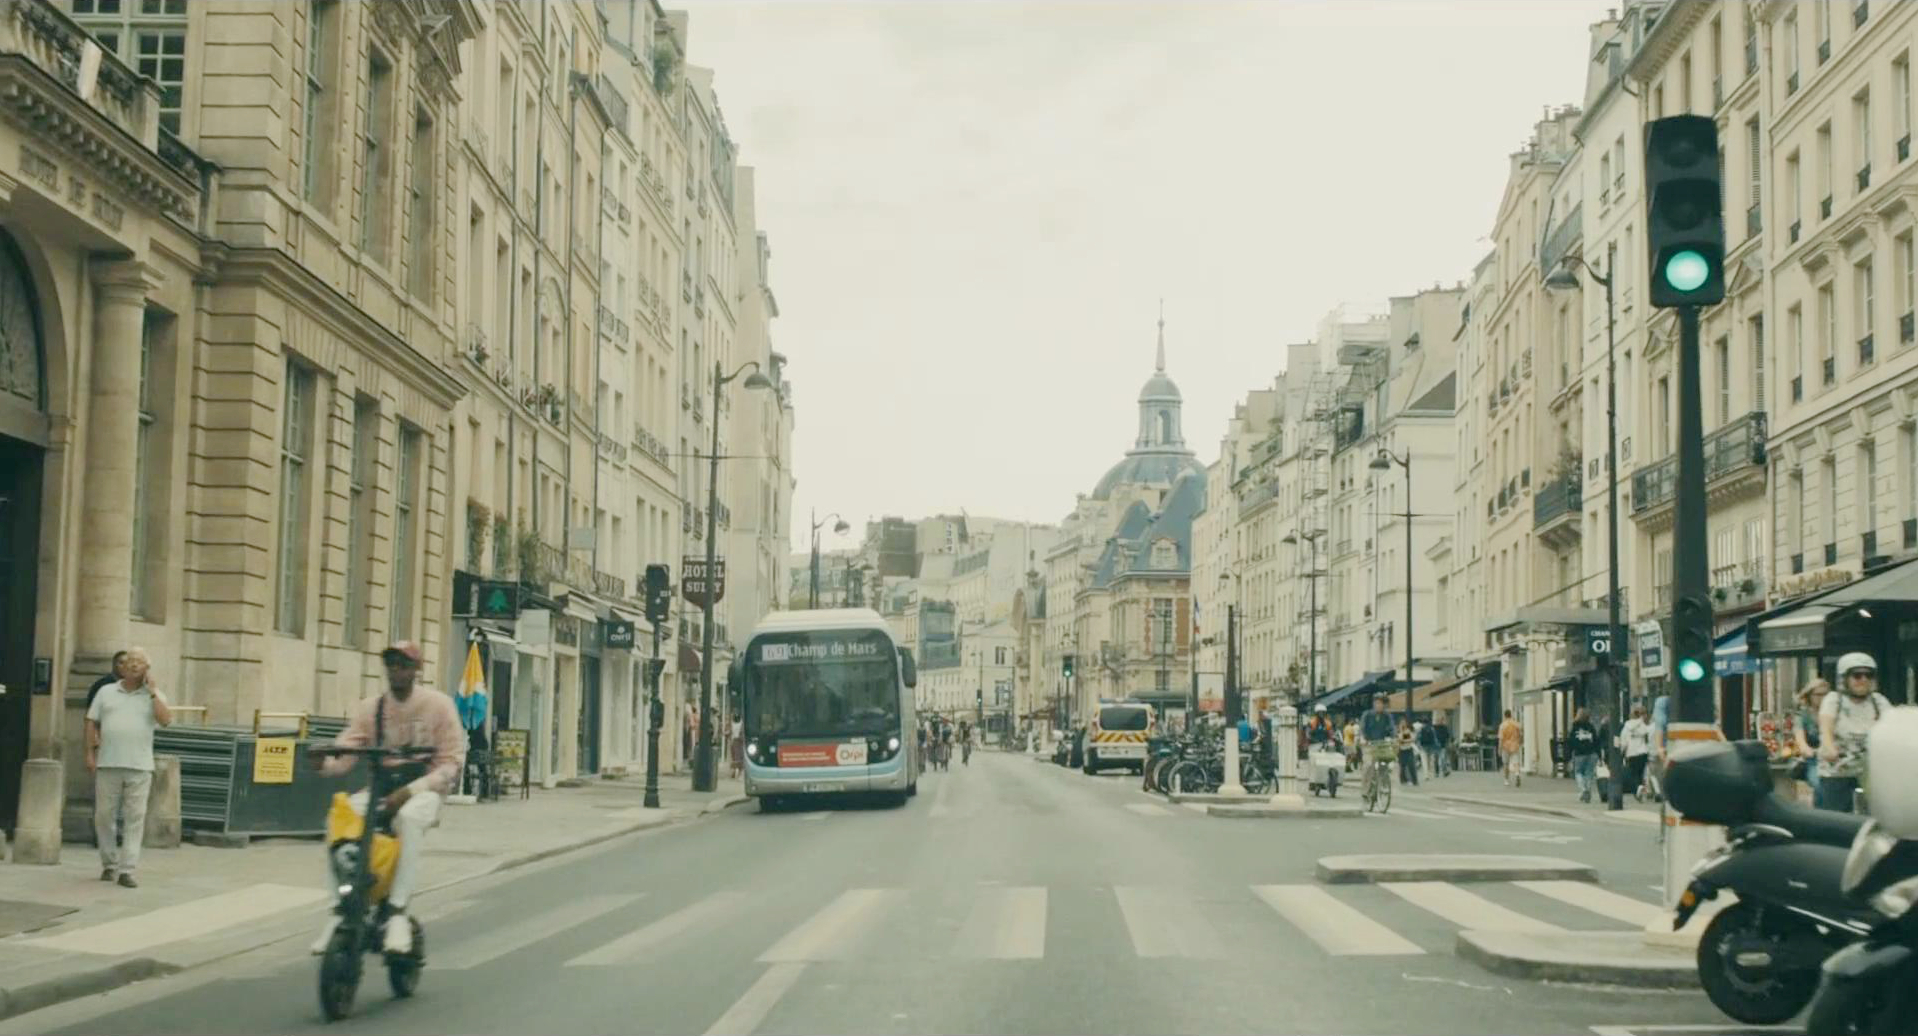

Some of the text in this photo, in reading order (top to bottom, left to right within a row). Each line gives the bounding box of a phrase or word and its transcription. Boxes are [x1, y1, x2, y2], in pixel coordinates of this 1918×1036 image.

[682, 564, 724, 578] HOTL
[686, 581, 722, 593] SULY
[788, 642, 828, 659] Champ
[831, 641, 845, 655] de
[848, 642, 877, 655] Mars
[840, 748, 864, 762] Orpi
